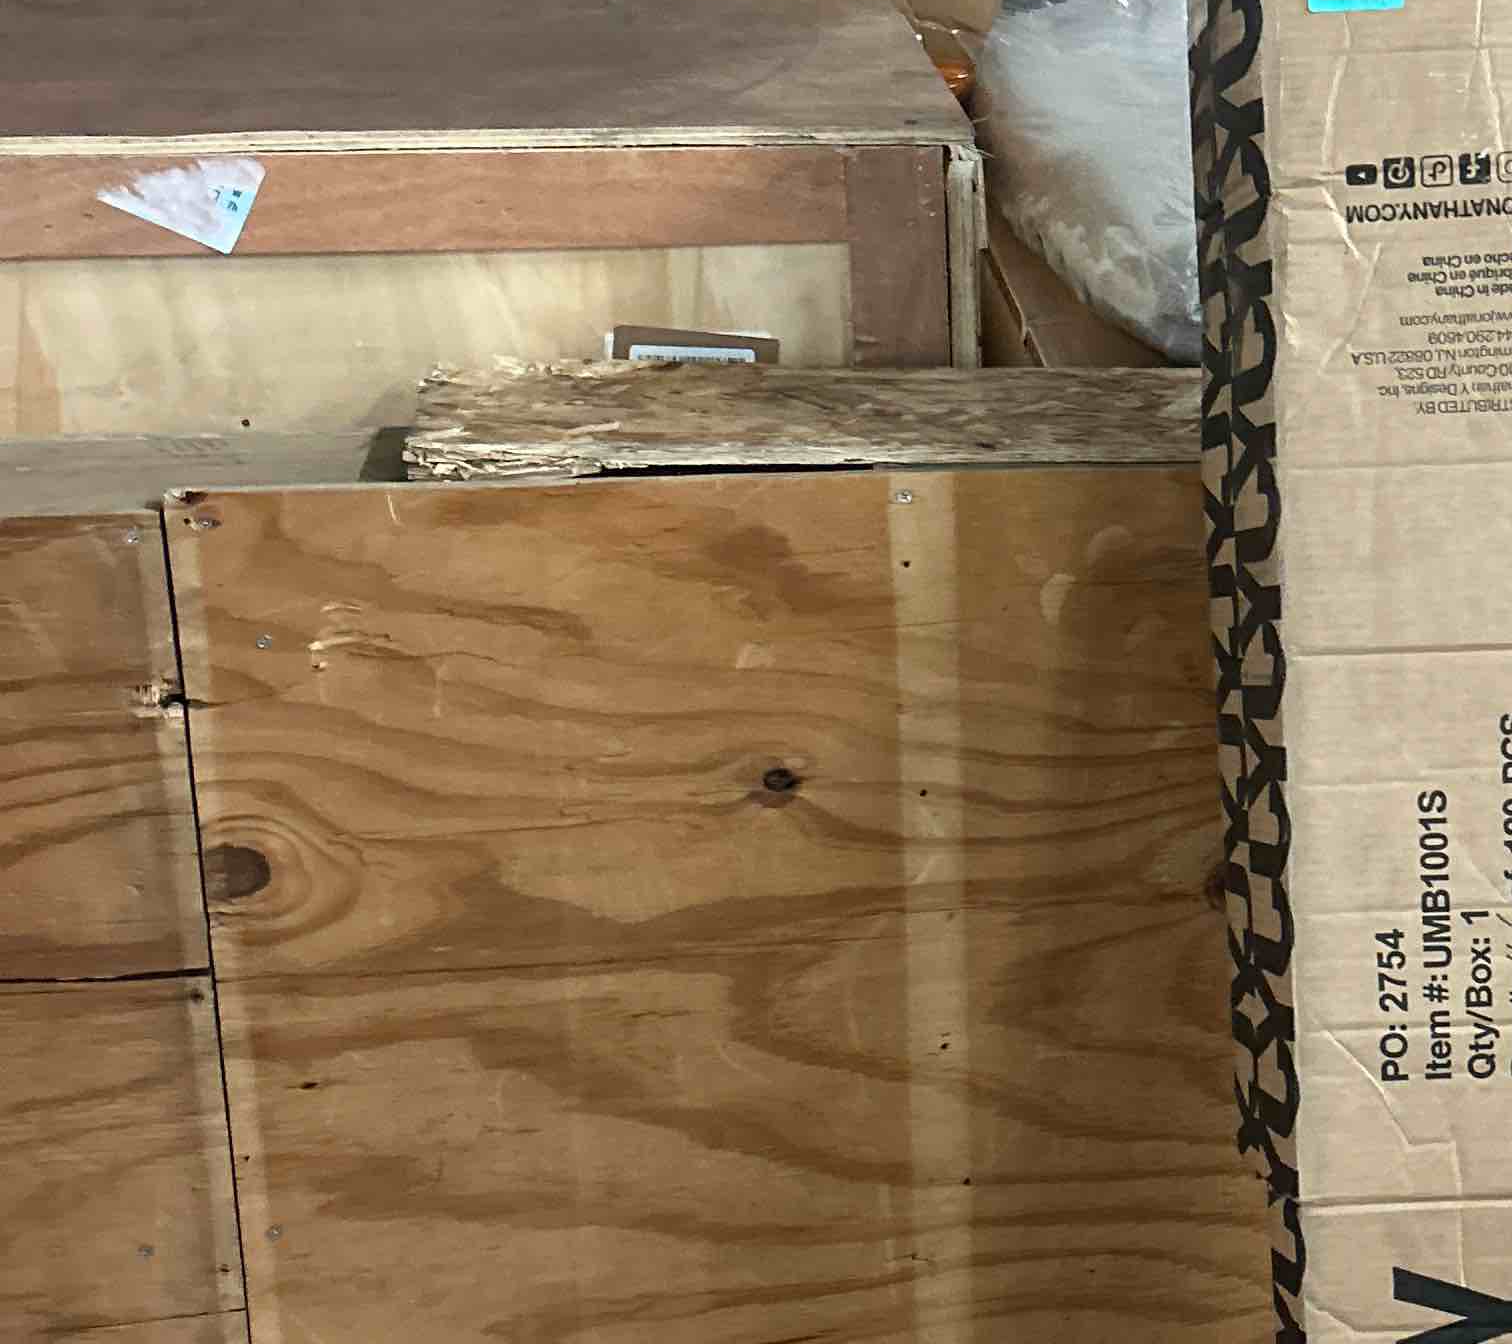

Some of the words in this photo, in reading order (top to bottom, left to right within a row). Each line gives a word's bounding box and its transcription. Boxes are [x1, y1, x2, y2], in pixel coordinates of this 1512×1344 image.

[1422, 256, 1462, 269] China
[1464, 255, 1481, 268] en
[1449, 270, 1466, 281] en
[1435, 285, 1475, 297] China
[1477, 284, 1490, 296] in
[1448, 363, 1497, 378] County
[1458, 382, 1469, 395] Y
[1417, 789, 1452, 969] UMB1001S
[1460, 909, 1490, 925] 1
[1375, 928, 1408, 1013] 2754
[1466, 937, 1501, 1080] Qty/Box:
[1424, 1009, 1452, 1080] Item
[1379, 1023, 1410, 1082] PO:
